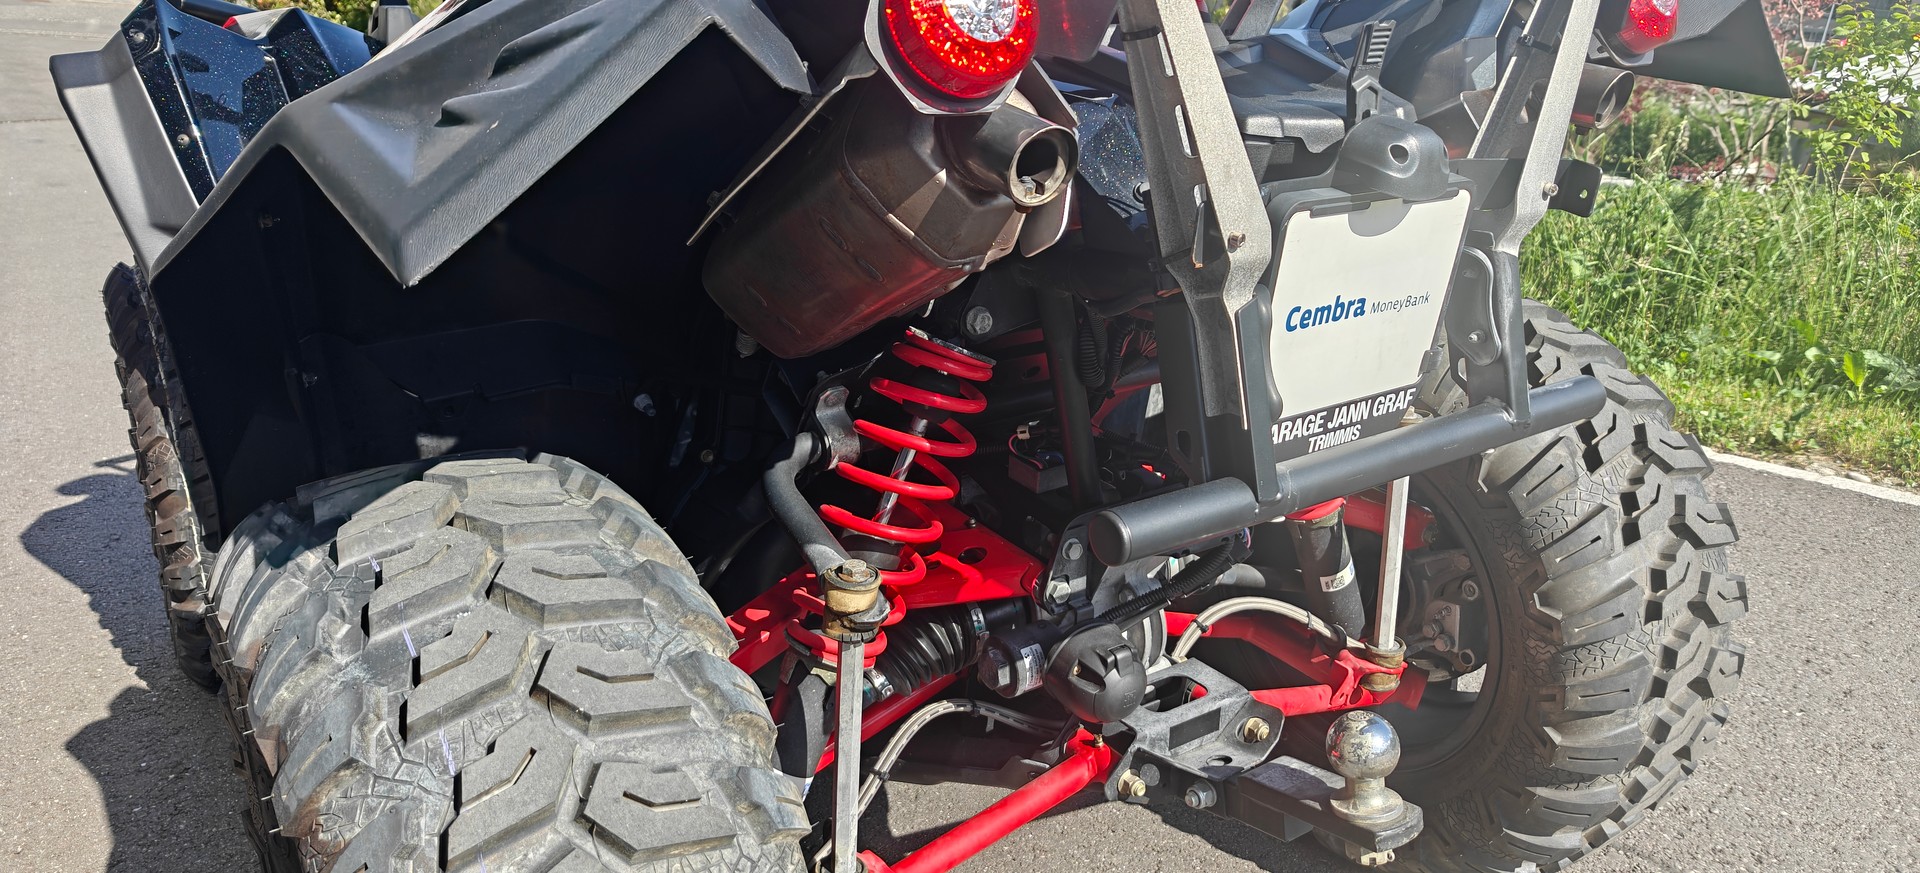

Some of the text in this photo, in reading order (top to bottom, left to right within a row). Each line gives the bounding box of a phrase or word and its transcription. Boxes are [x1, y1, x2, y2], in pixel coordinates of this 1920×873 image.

[1285, 291, 1431, 333] Cembra MoneyBank
[1271, 387, 1417, 445] ARAGE JANN GRAF
[1308, 424, 1361, 454] TRIMMIS
